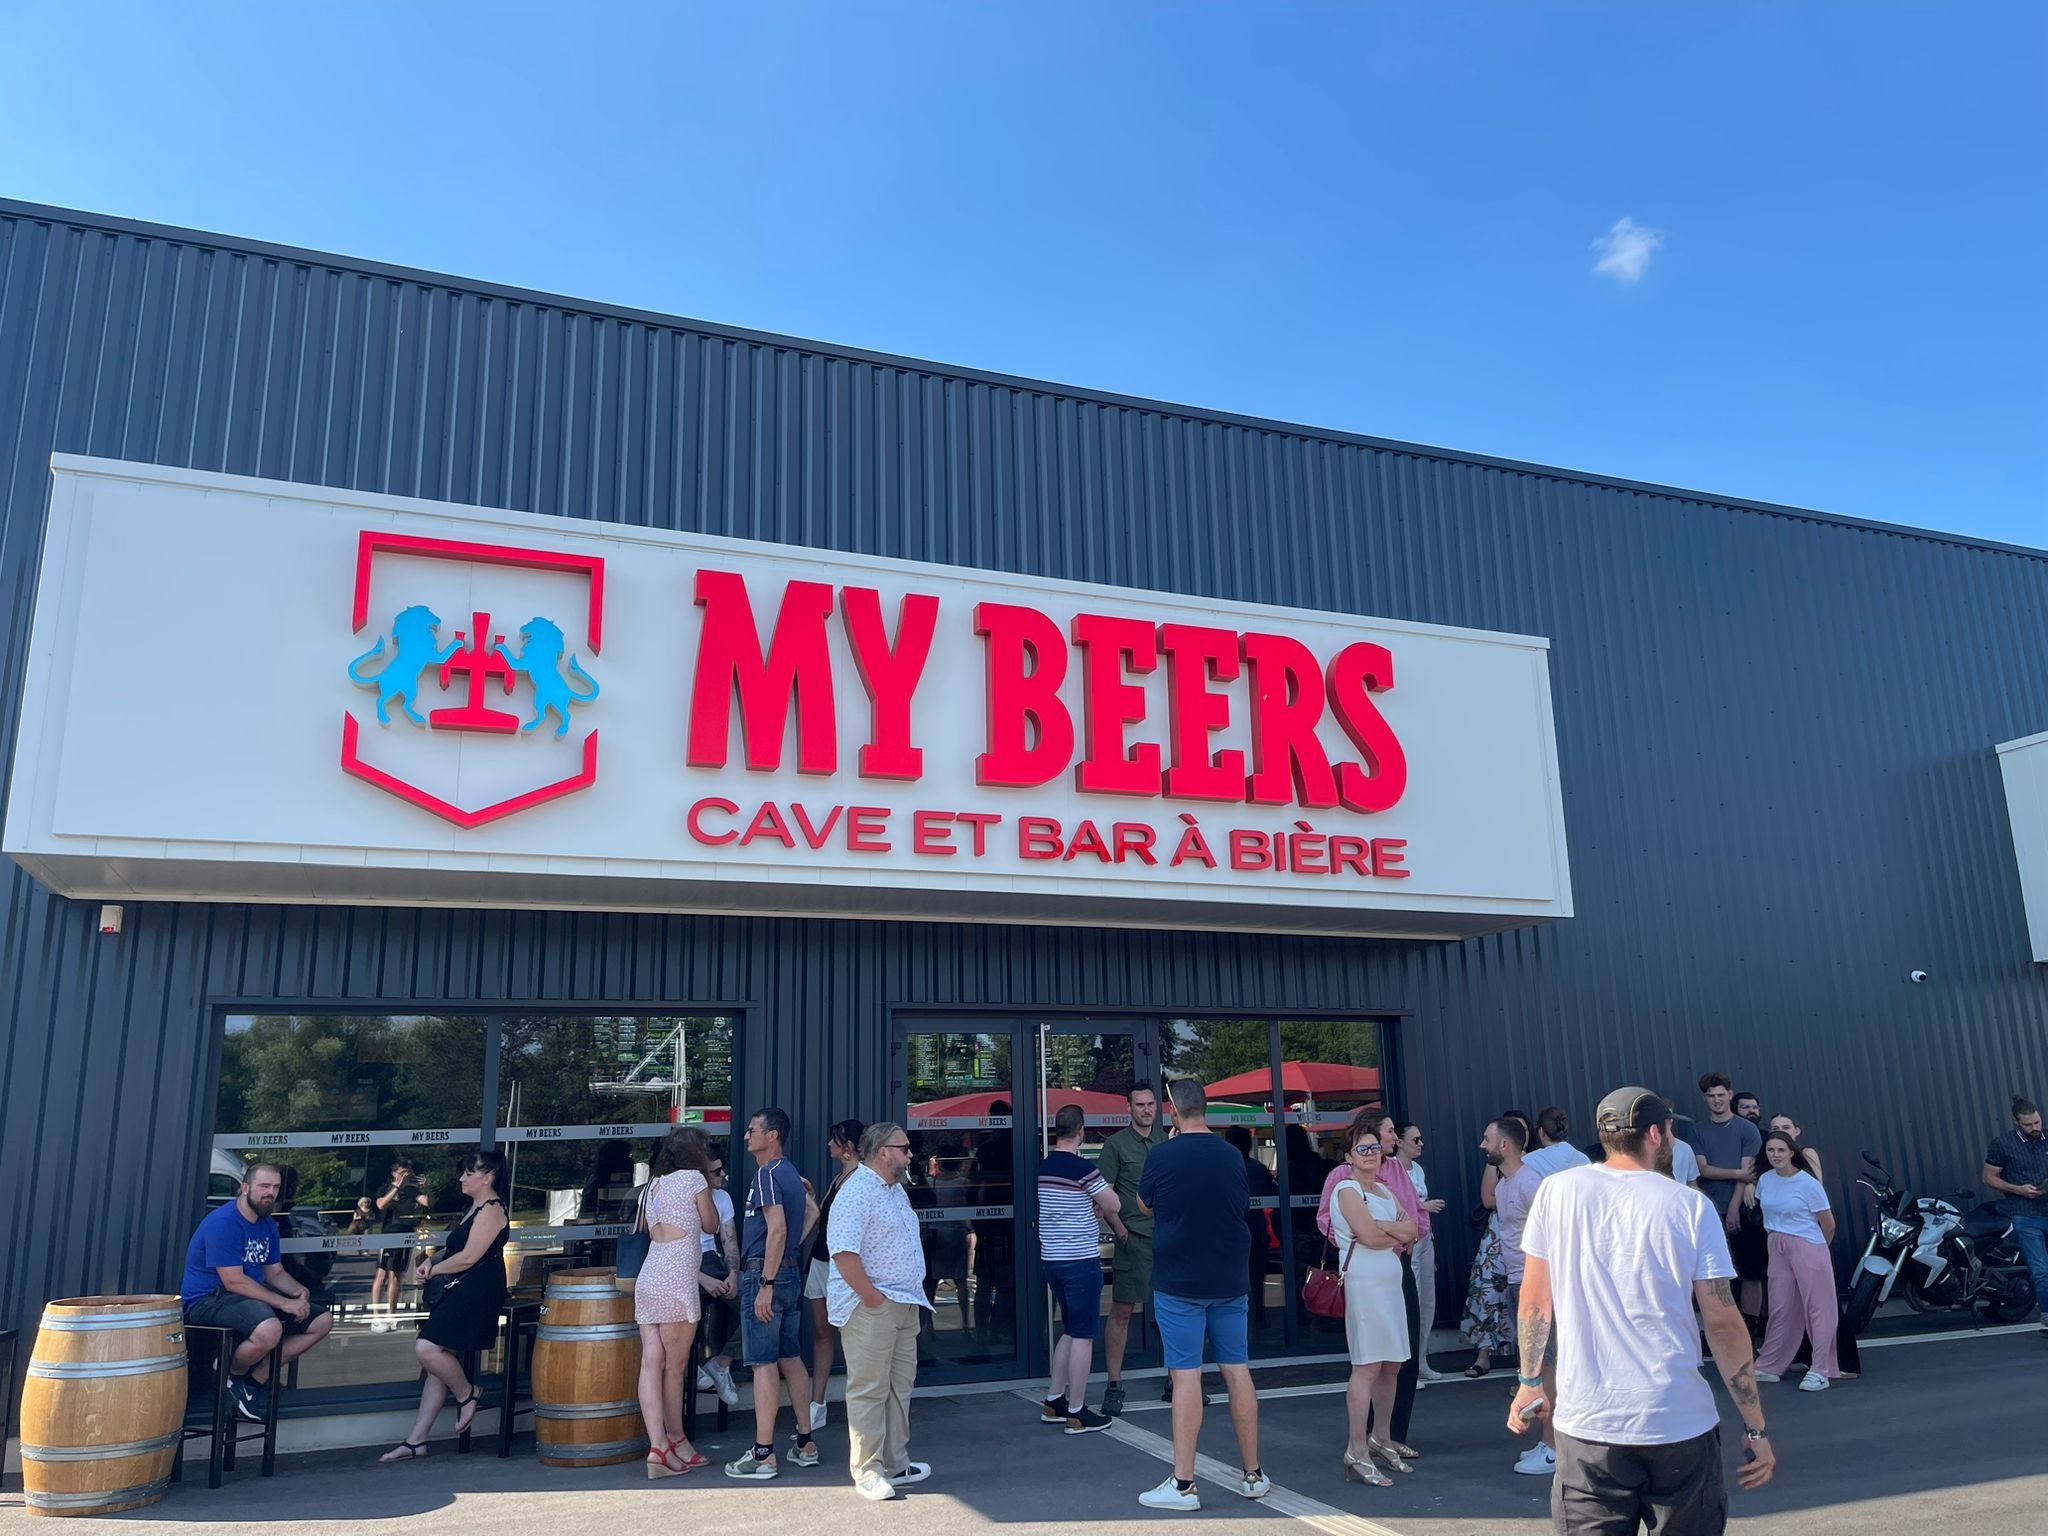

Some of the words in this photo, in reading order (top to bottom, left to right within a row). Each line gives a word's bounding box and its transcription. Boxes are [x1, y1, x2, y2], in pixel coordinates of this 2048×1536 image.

[686, 568, 939, 782] MY
[972, 601, 1408, 815] BEERS
[686, 796, 892, 853] CAVE
[913, 810, 1002, 857] ET
[1018, 816, 1159, 866] BAR
[1169, 813, 1218, 869] À
[1229, 821, 1411, 879] BIÈRE
[918, 1118, 928, 1128] MY
[929, 1118, 948, 1127] BEERS
[989, 1117, 1007, 1126] BEERS
[526, 1129, 538, 1138] MY
[539, 1128, 562, 1138] BEERS
[599, 1127, 611, 1136] MY
[612, 1126, 634, 1135] BEERS
[248, 1135, 261, 1145] MY
[262, 1135, 288, 1145] BEERS
[331, 1134, 344, 1144] MY
[345, 1133, 370, 1143] BEERS
[412, 1132, 424, 1142] MY
[425, 1131, 450, 1141] BEERS
[925, 1210, 944, 1219] BEERS
[975, 1208, 985, 1217] MY
[986, 1207, 1005, 1216] BEERS
[595, 1228, 606, 1236] MY
[608, 1226, 630, 1235] BEERS
[322, 1239, 335, 1249] MY
[336, 1238, 362, 1248] BEERS
